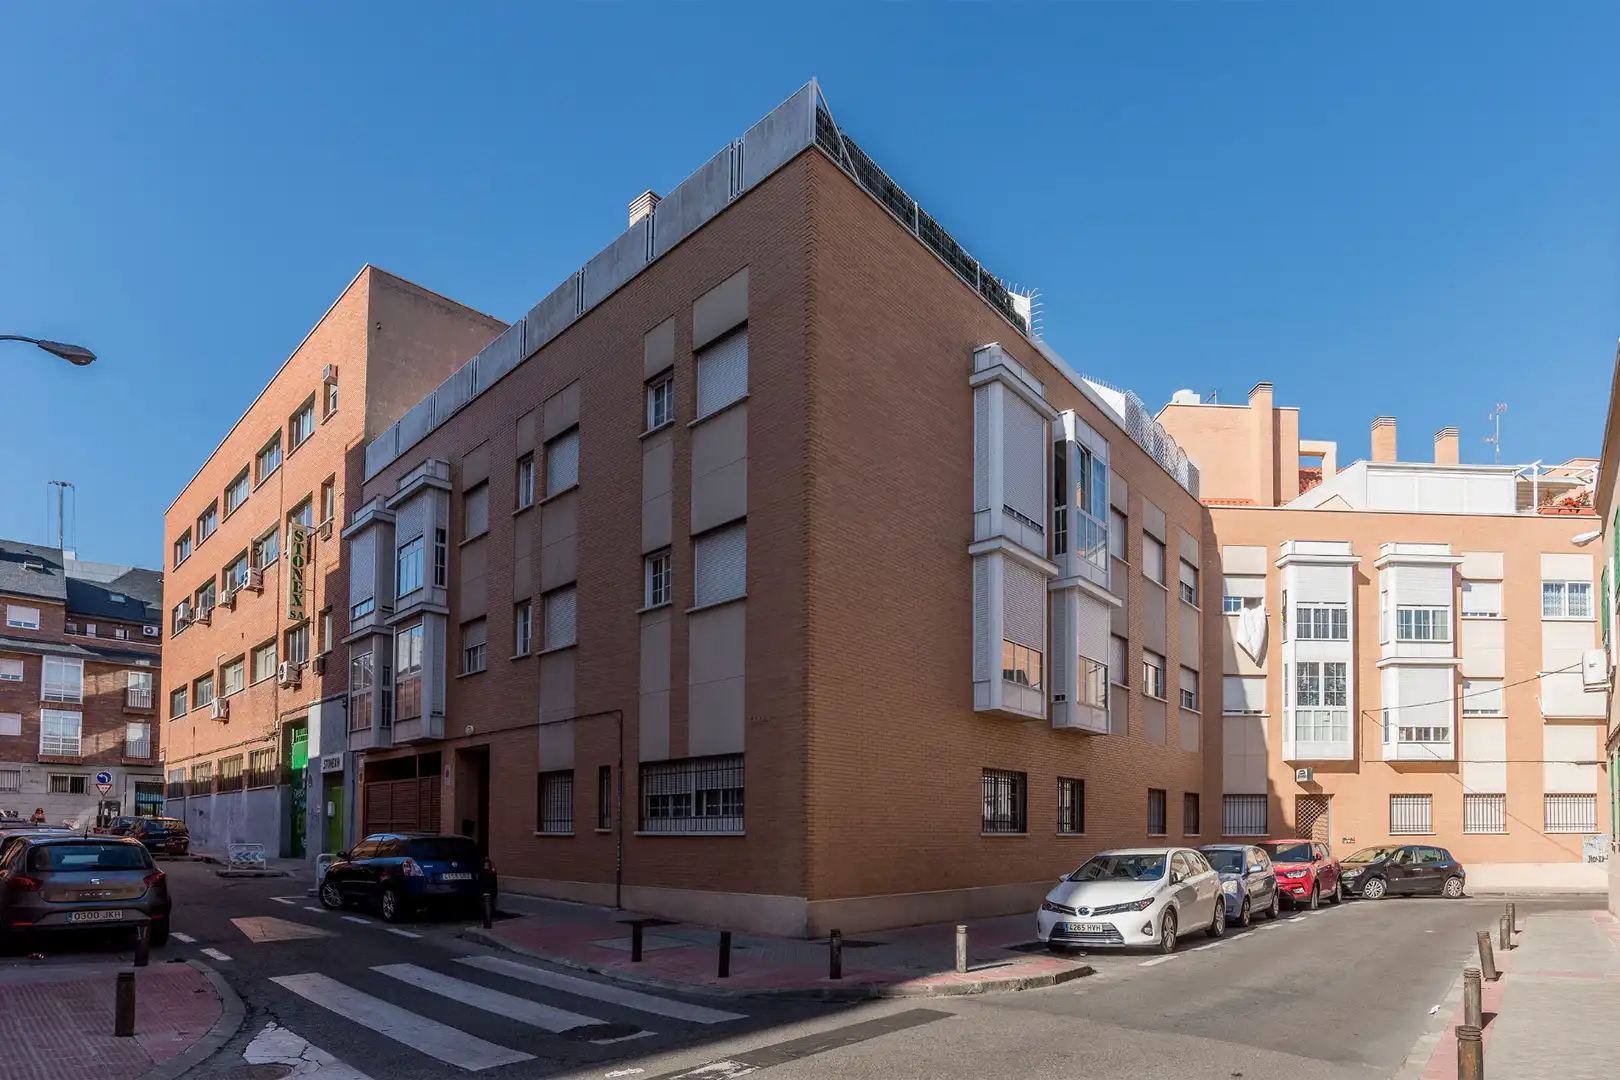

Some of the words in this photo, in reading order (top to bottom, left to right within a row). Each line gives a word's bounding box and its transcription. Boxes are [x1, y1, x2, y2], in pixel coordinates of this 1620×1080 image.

[292, 530, 304, 607] STONEX
[74, 912, 99, 920] 0300
[103, 911, 121, 919] JKH
